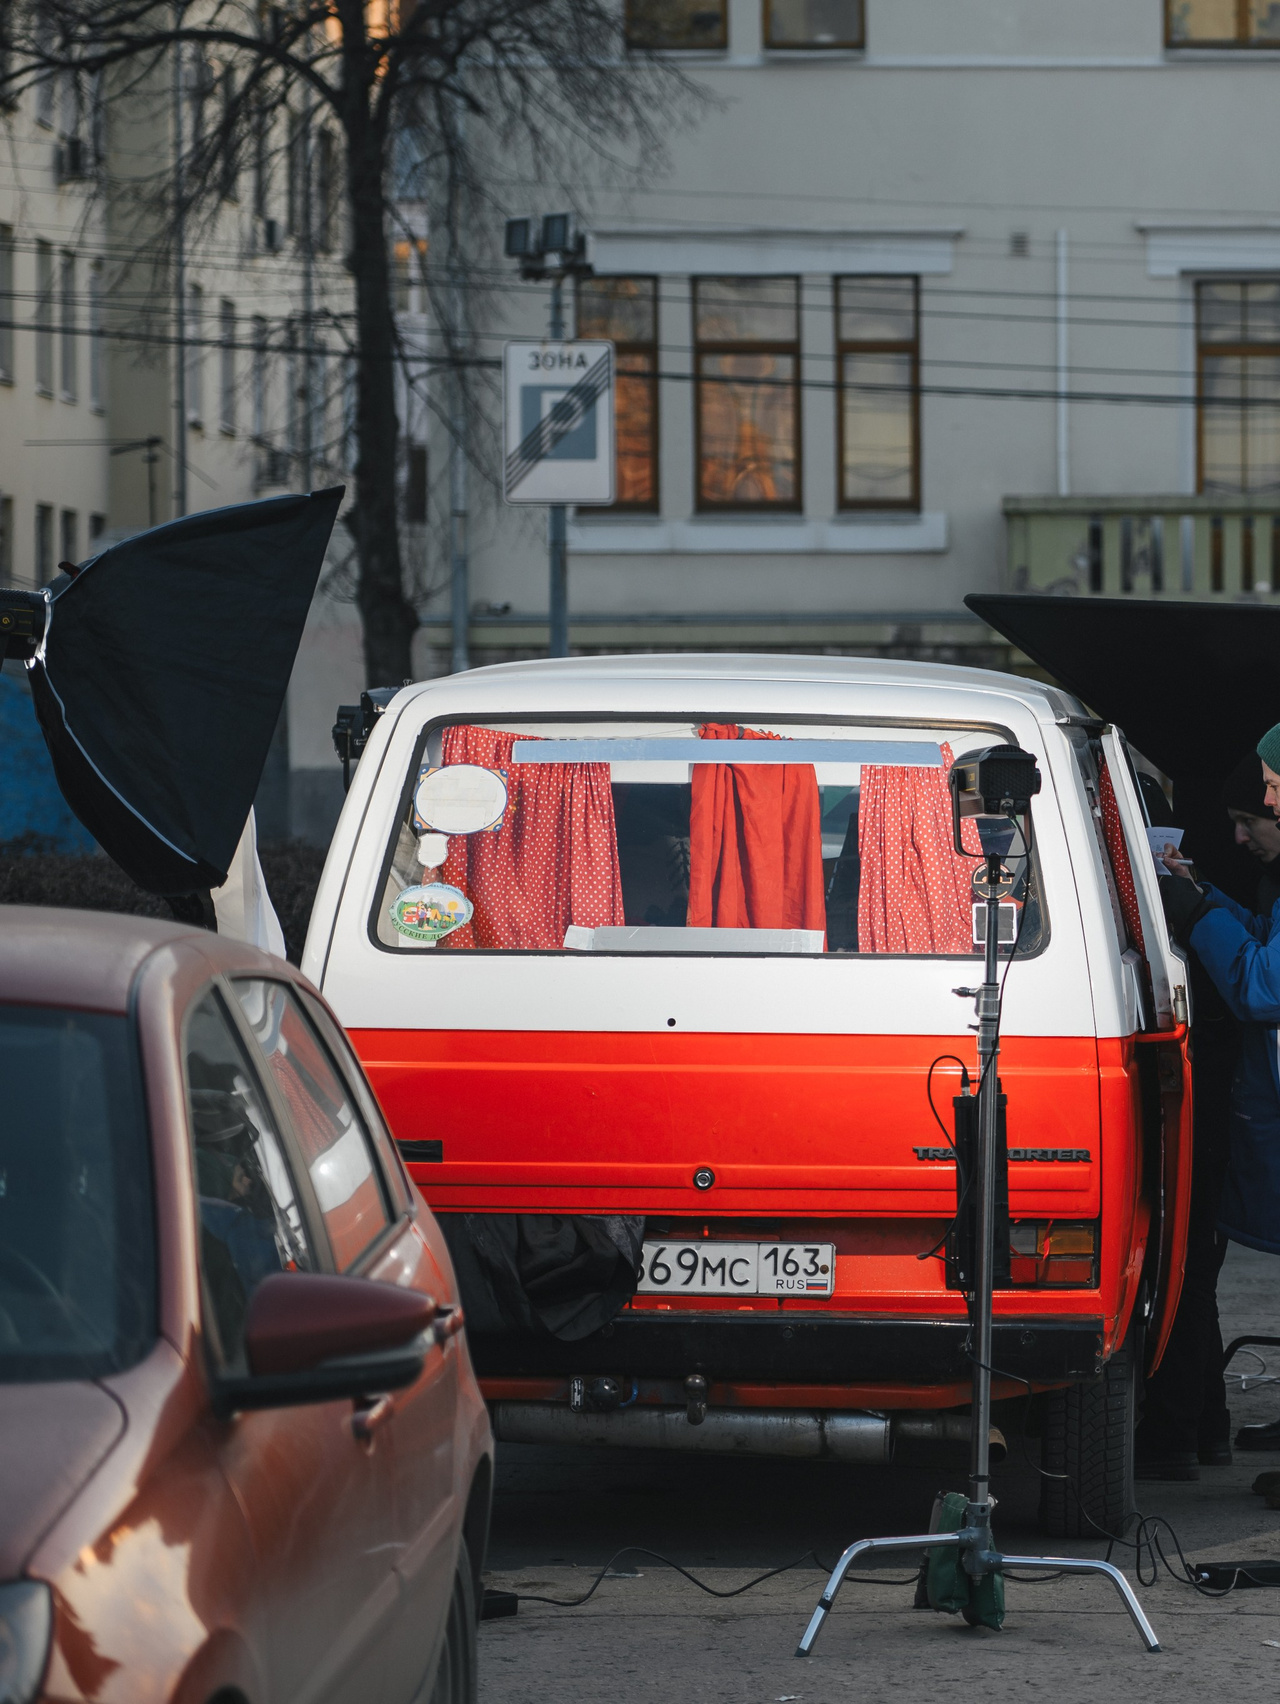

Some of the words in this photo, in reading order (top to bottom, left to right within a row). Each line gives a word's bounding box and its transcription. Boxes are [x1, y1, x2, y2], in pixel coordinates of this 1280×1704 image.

[528, 351, 589, 371] ЗОНА
[391, 917, 428, 939] РУССКИЕ
[913, 1146, 1093, 1163] TRAORTER
[764, 1247, 820, 1277] 163
[776, 1279, 805, 1290] RUS
